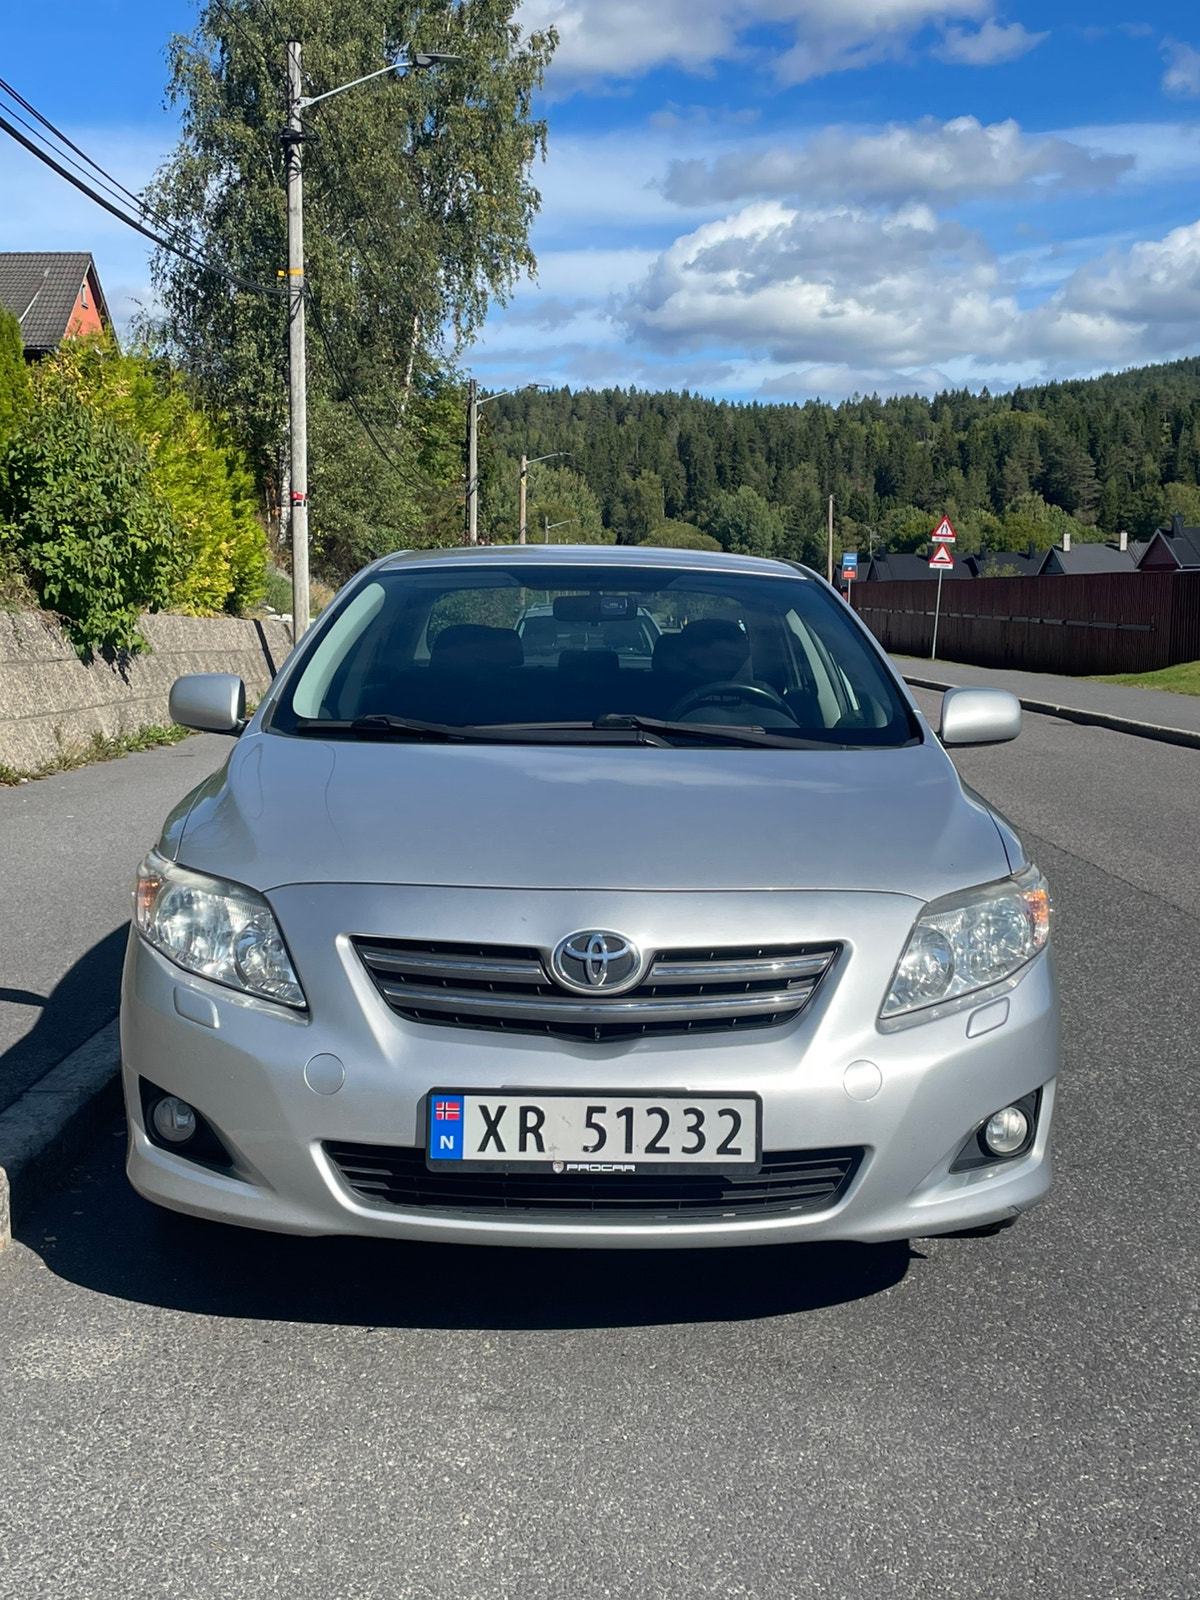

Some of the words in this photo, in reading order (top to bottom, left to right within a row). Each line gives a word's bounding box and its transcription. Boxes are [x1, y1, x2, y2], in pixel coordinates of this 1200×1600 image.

[477, 1104, 546, 1153] XR
[582, 1105, 742, 1156] 51232
[440, 1135, 454, 1150] N
[566, 1163, 636, 1172] PROCAR
